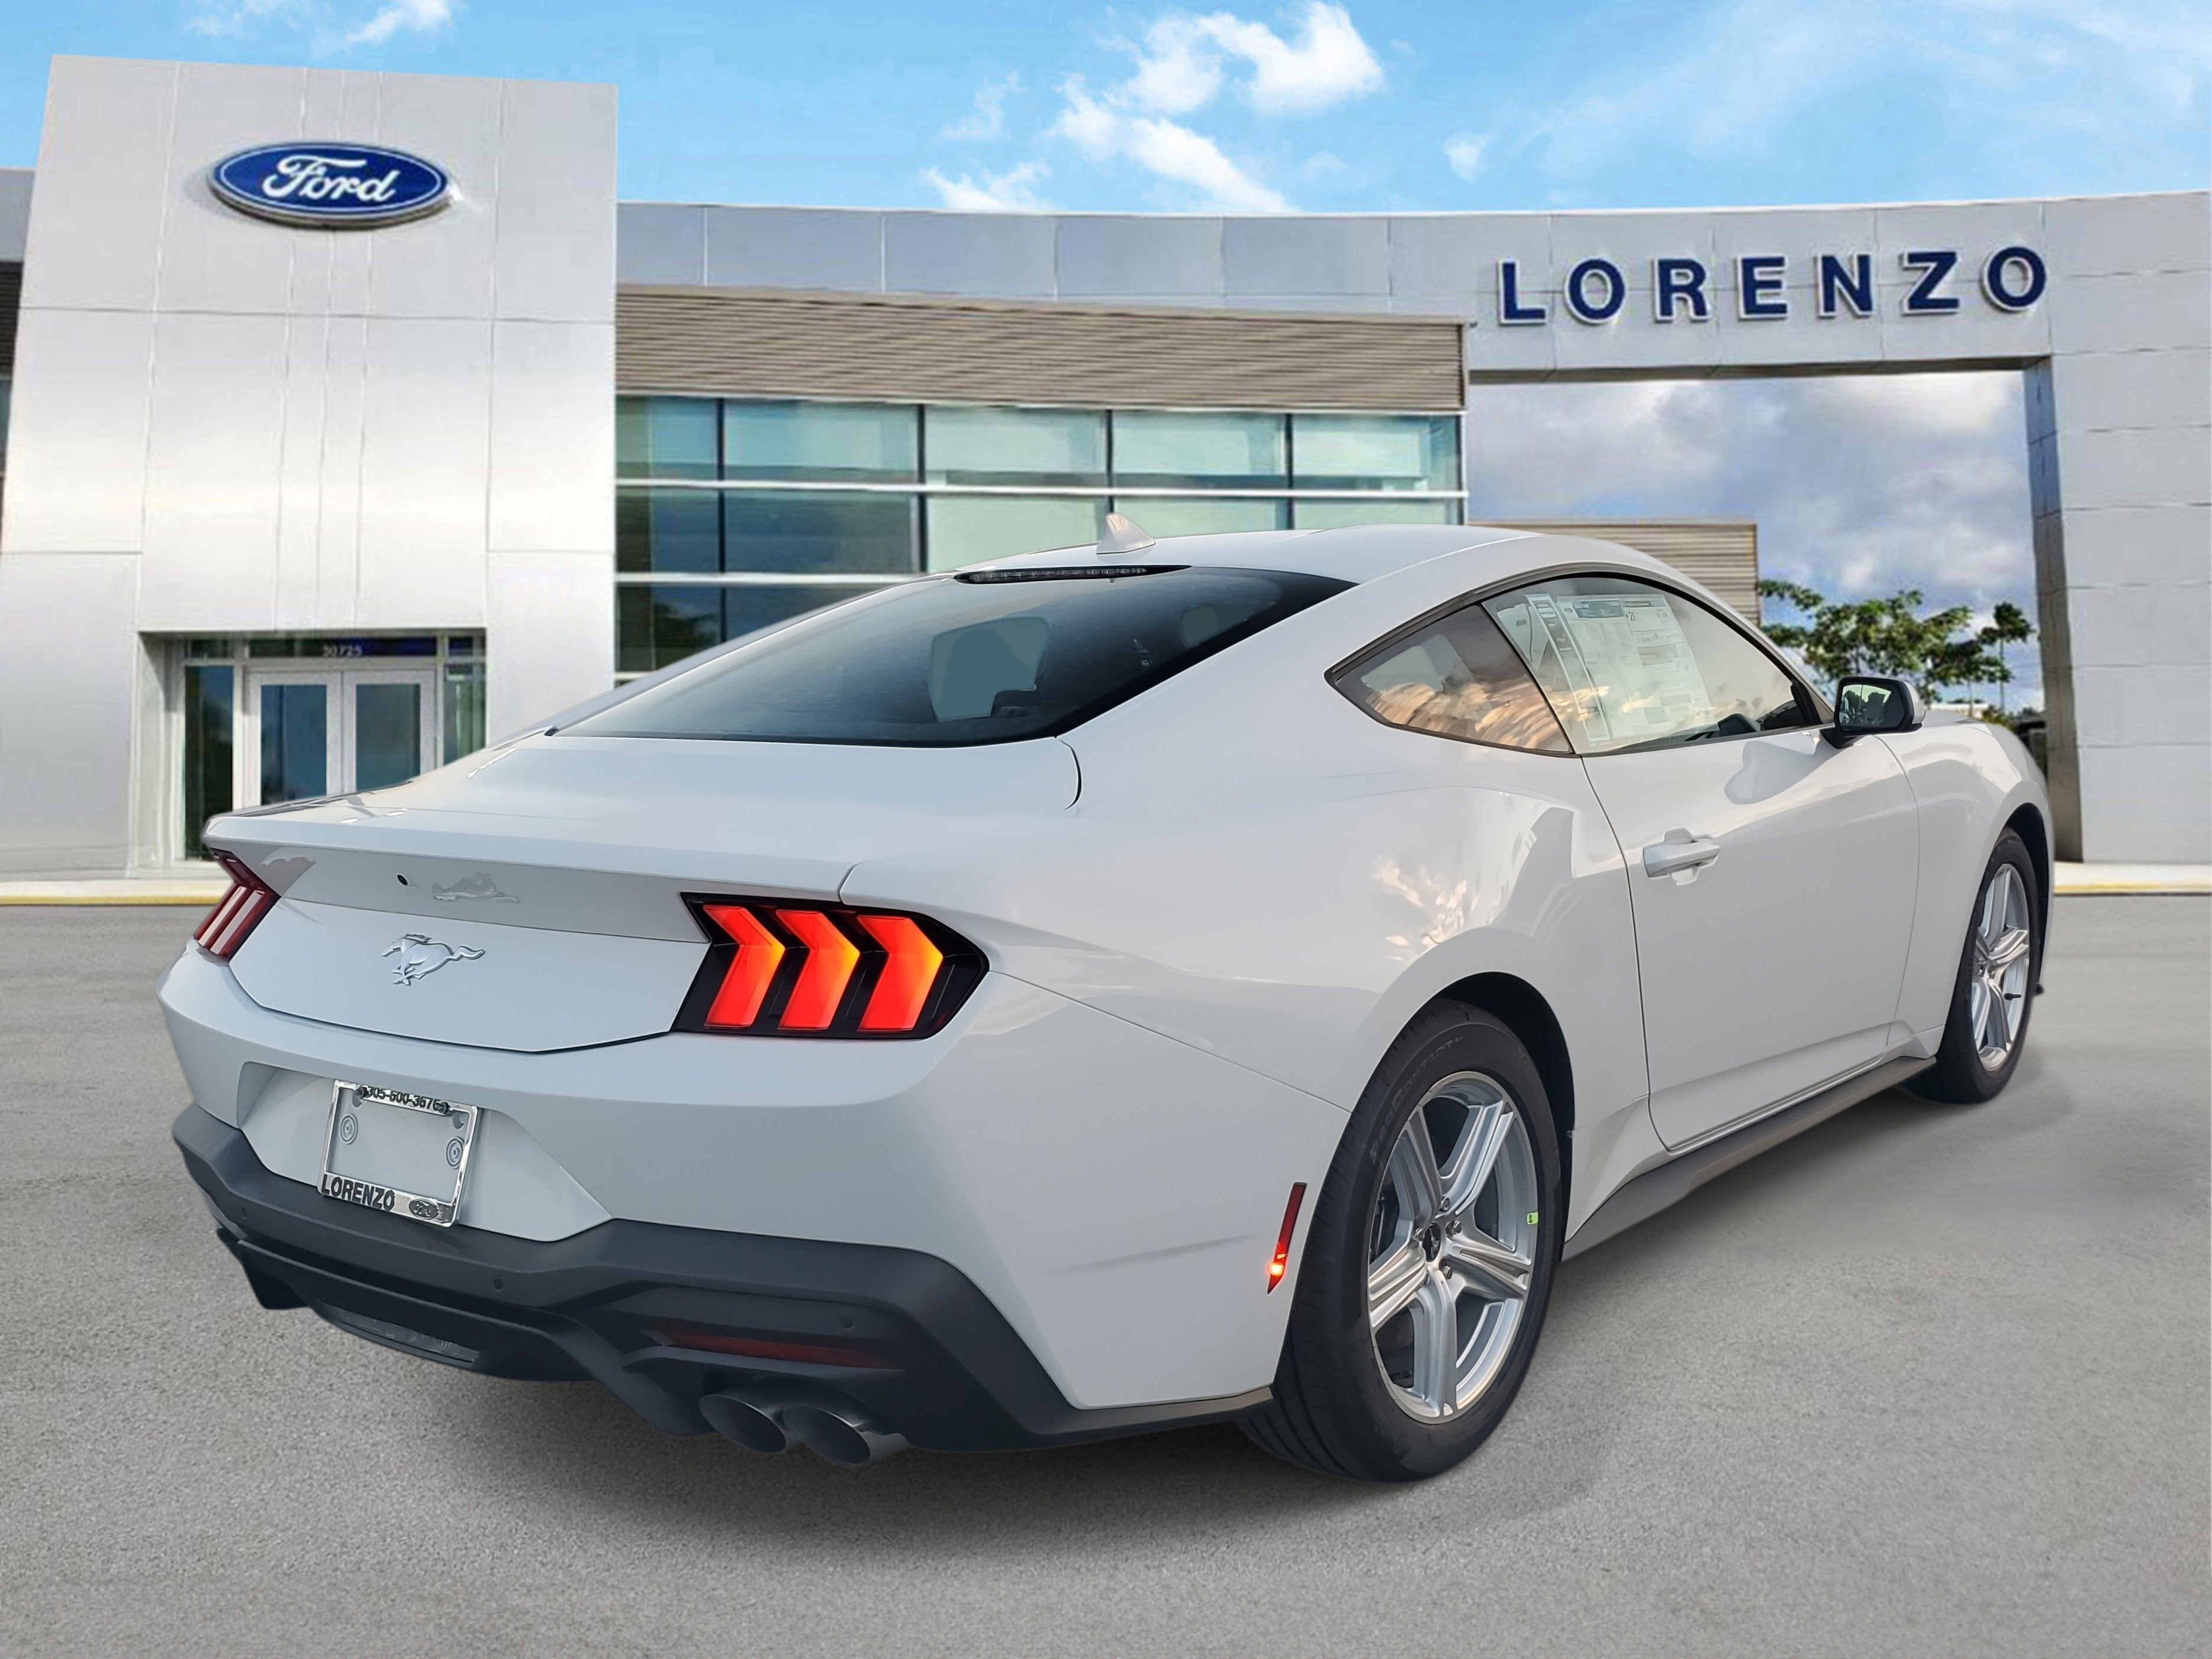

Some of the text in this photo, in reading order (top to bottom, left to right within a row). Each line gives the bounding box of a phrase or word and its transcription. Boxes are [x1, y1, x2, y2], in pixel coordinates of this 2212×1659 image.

[262, 154, 401, 202] Ford
[1499, 246, 2047, 325] LORENZO
[321, 1174, 395, 1211] LORENZO
